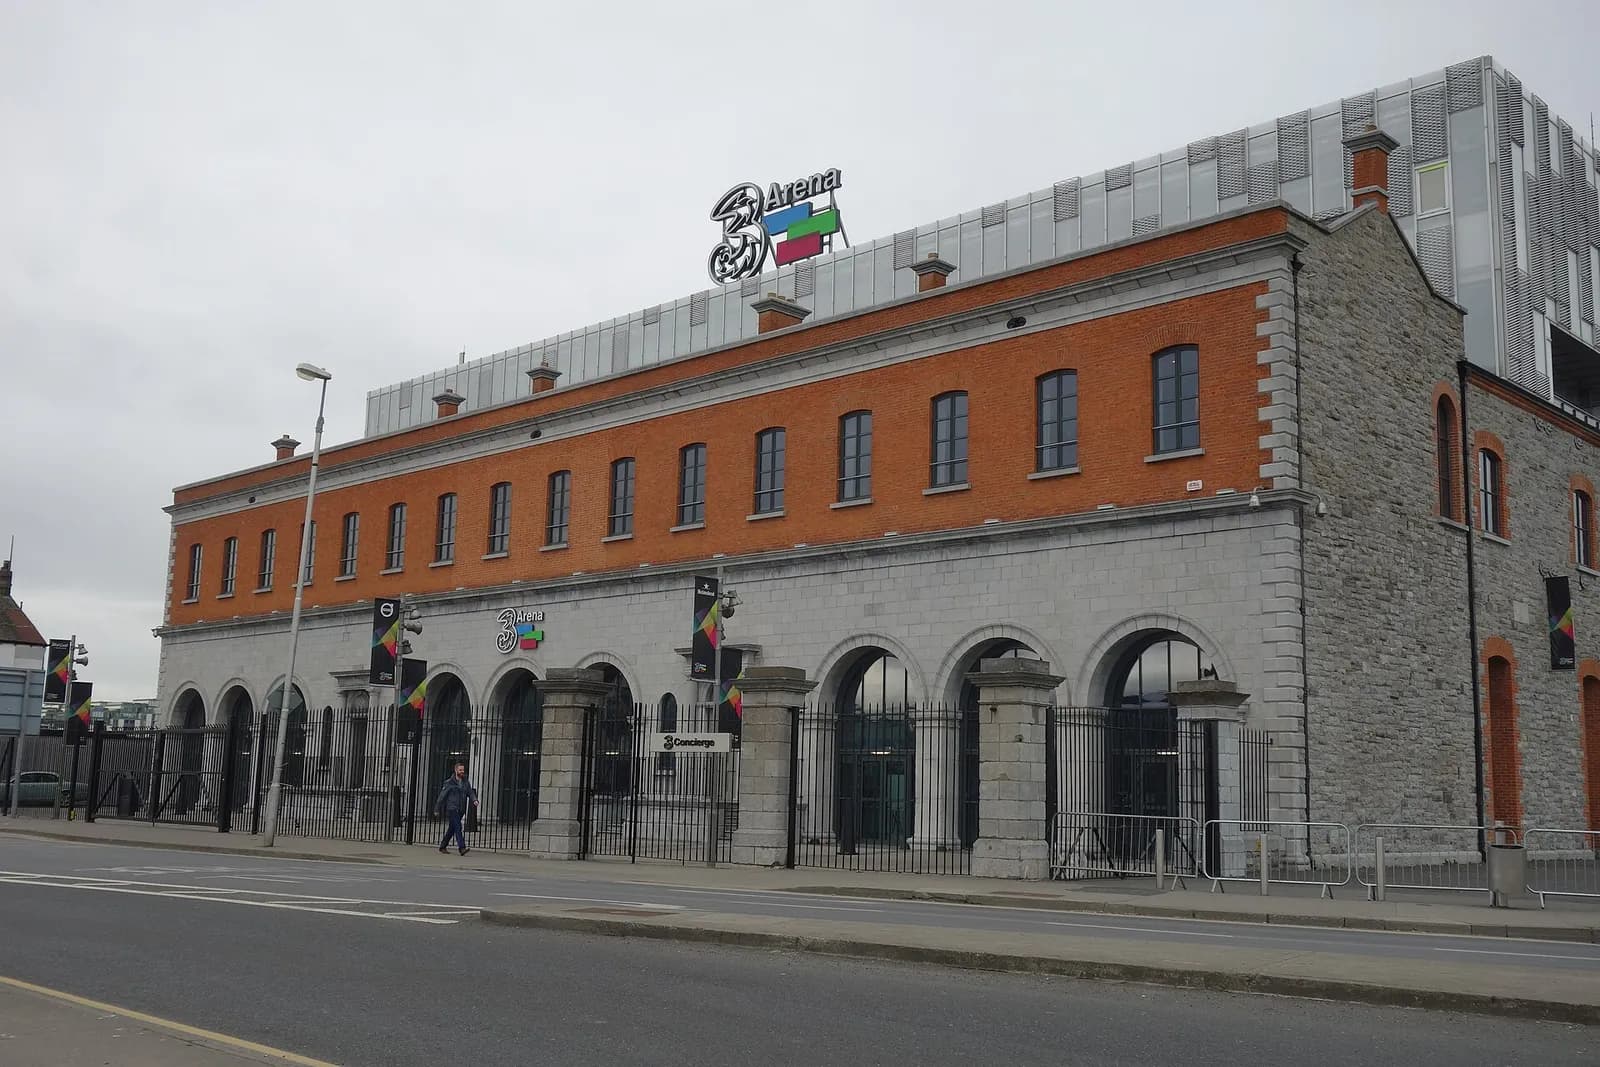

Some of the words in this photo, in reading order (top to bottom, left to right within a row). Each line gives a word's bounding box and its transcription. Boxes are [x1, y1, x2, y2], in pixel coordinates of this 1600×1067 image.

[764, 167, 843, 211] Arena
[496, 608, 518, 654] 3
[516, 610, 545, 622] Arena
[673, 737, 715, 748] Concierge
